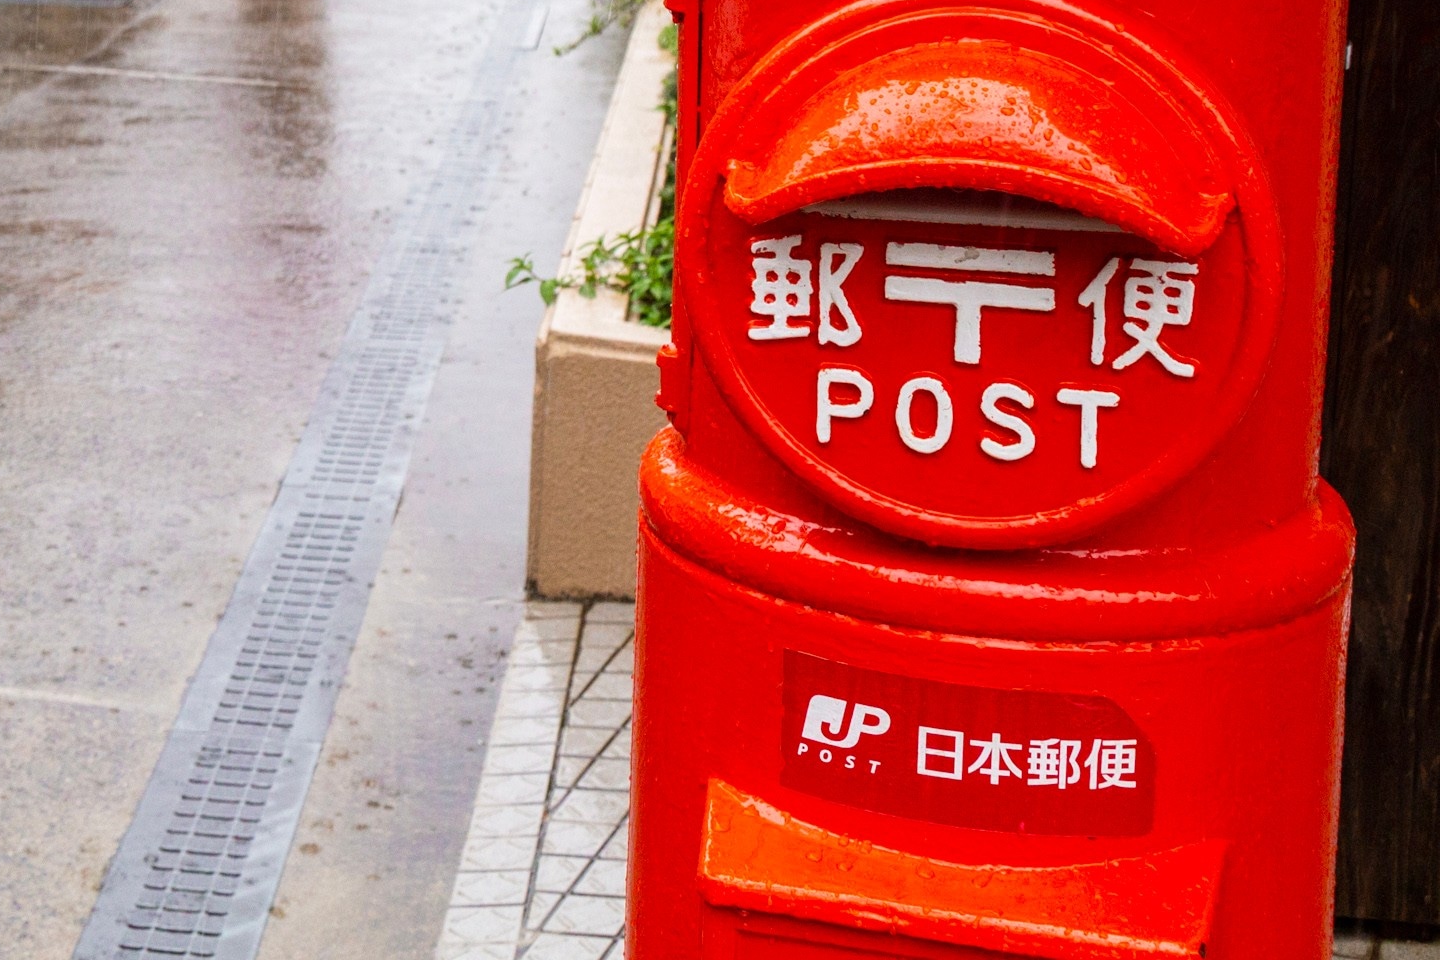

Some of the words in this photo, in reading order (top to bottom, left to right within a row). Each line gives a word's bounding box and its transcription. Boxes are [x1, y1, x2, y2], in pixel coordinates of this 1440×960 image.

[815, 367, 1122, 470] POST
[801, 693, 892, 749] JP
[796, 741, 882, 775] POST
[916, 724, 1138, 791] 日本郵便
